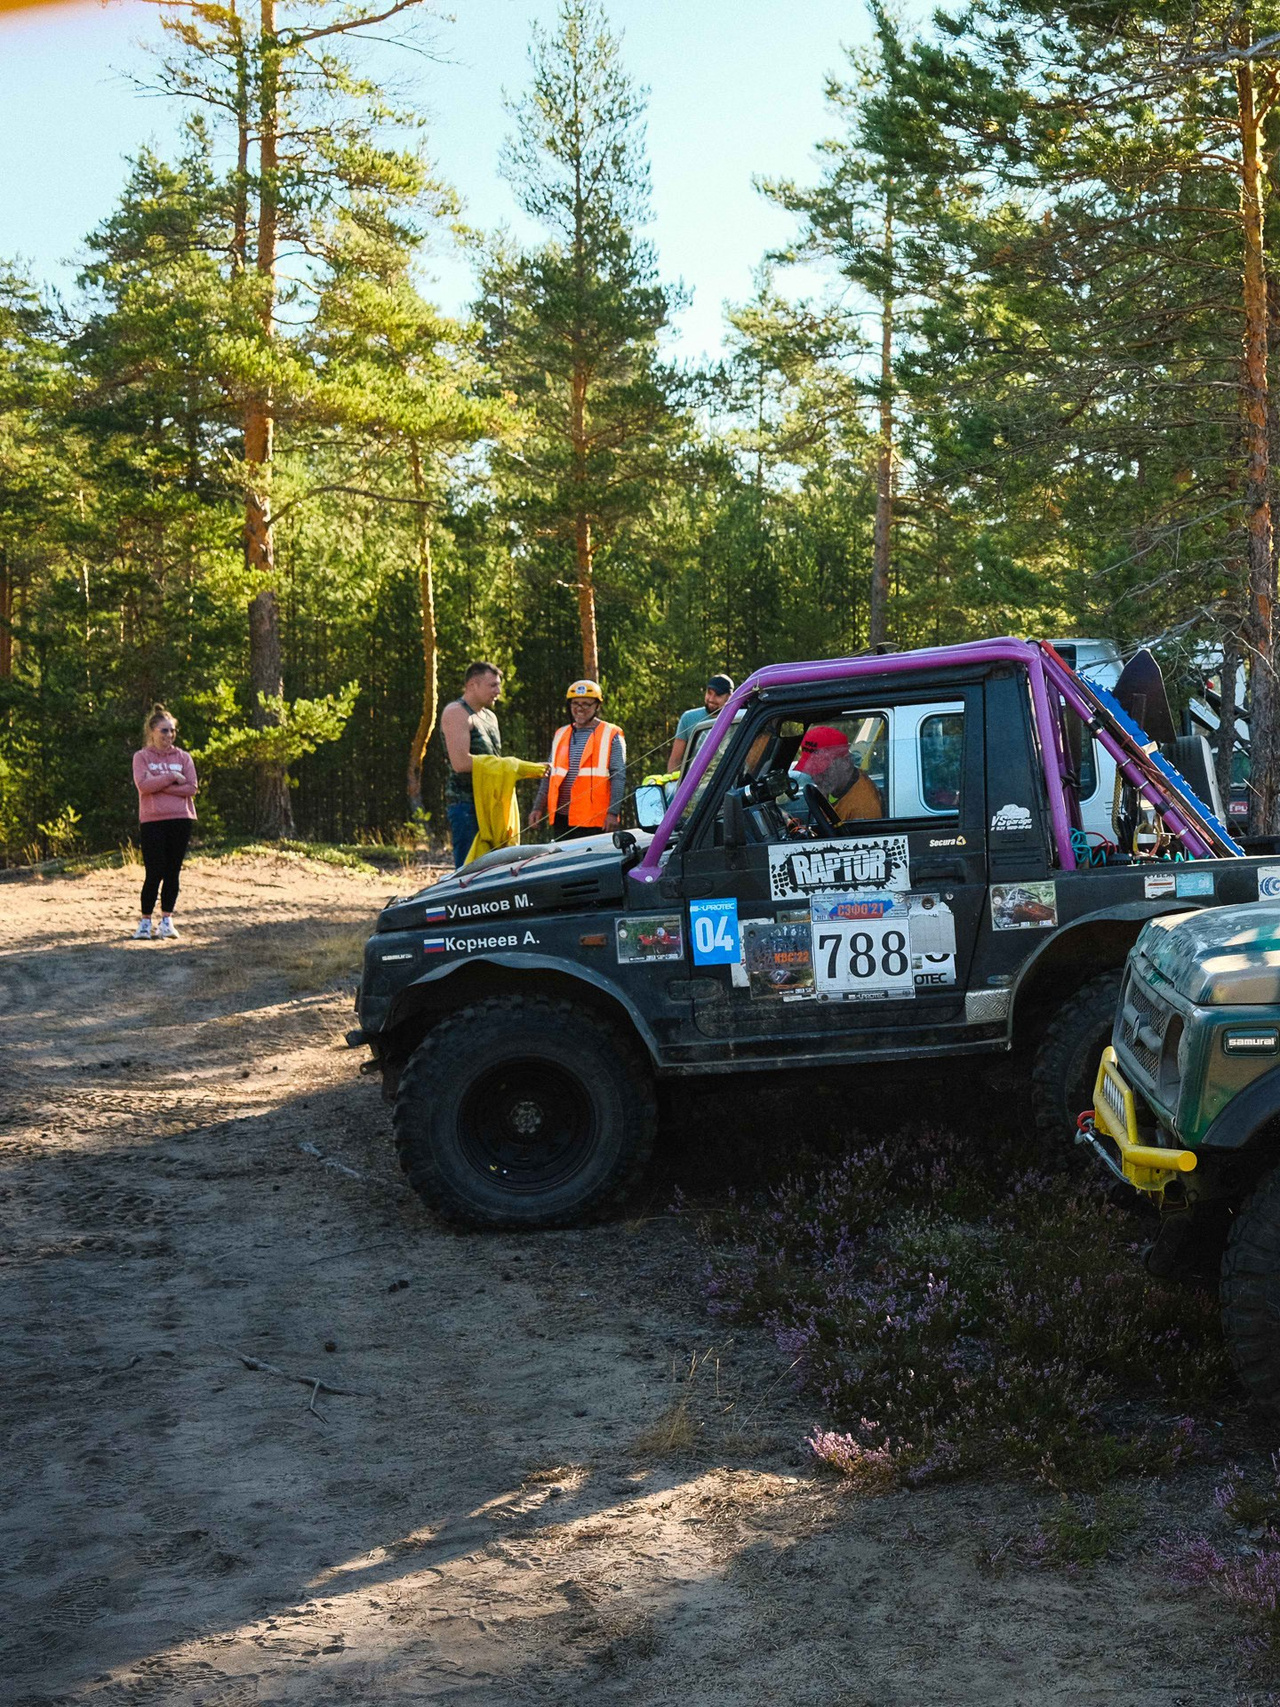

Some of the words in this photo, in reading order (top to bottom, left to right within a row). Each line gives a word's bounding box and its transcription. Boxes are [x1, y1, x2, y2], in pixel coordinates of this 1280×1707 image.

[929, 838, 956, 848] Secura
[791, 848, 887, 886] RAPTOR
[446, 899, 511, 919] Ушаков
[514, 893, 535, 909] М.
[445, 935, 518, 953] Корнеев
[523, 930, 541, 946] А.
[695, 915, 734, 954] 04
[818, 930, 909, 979] 788
